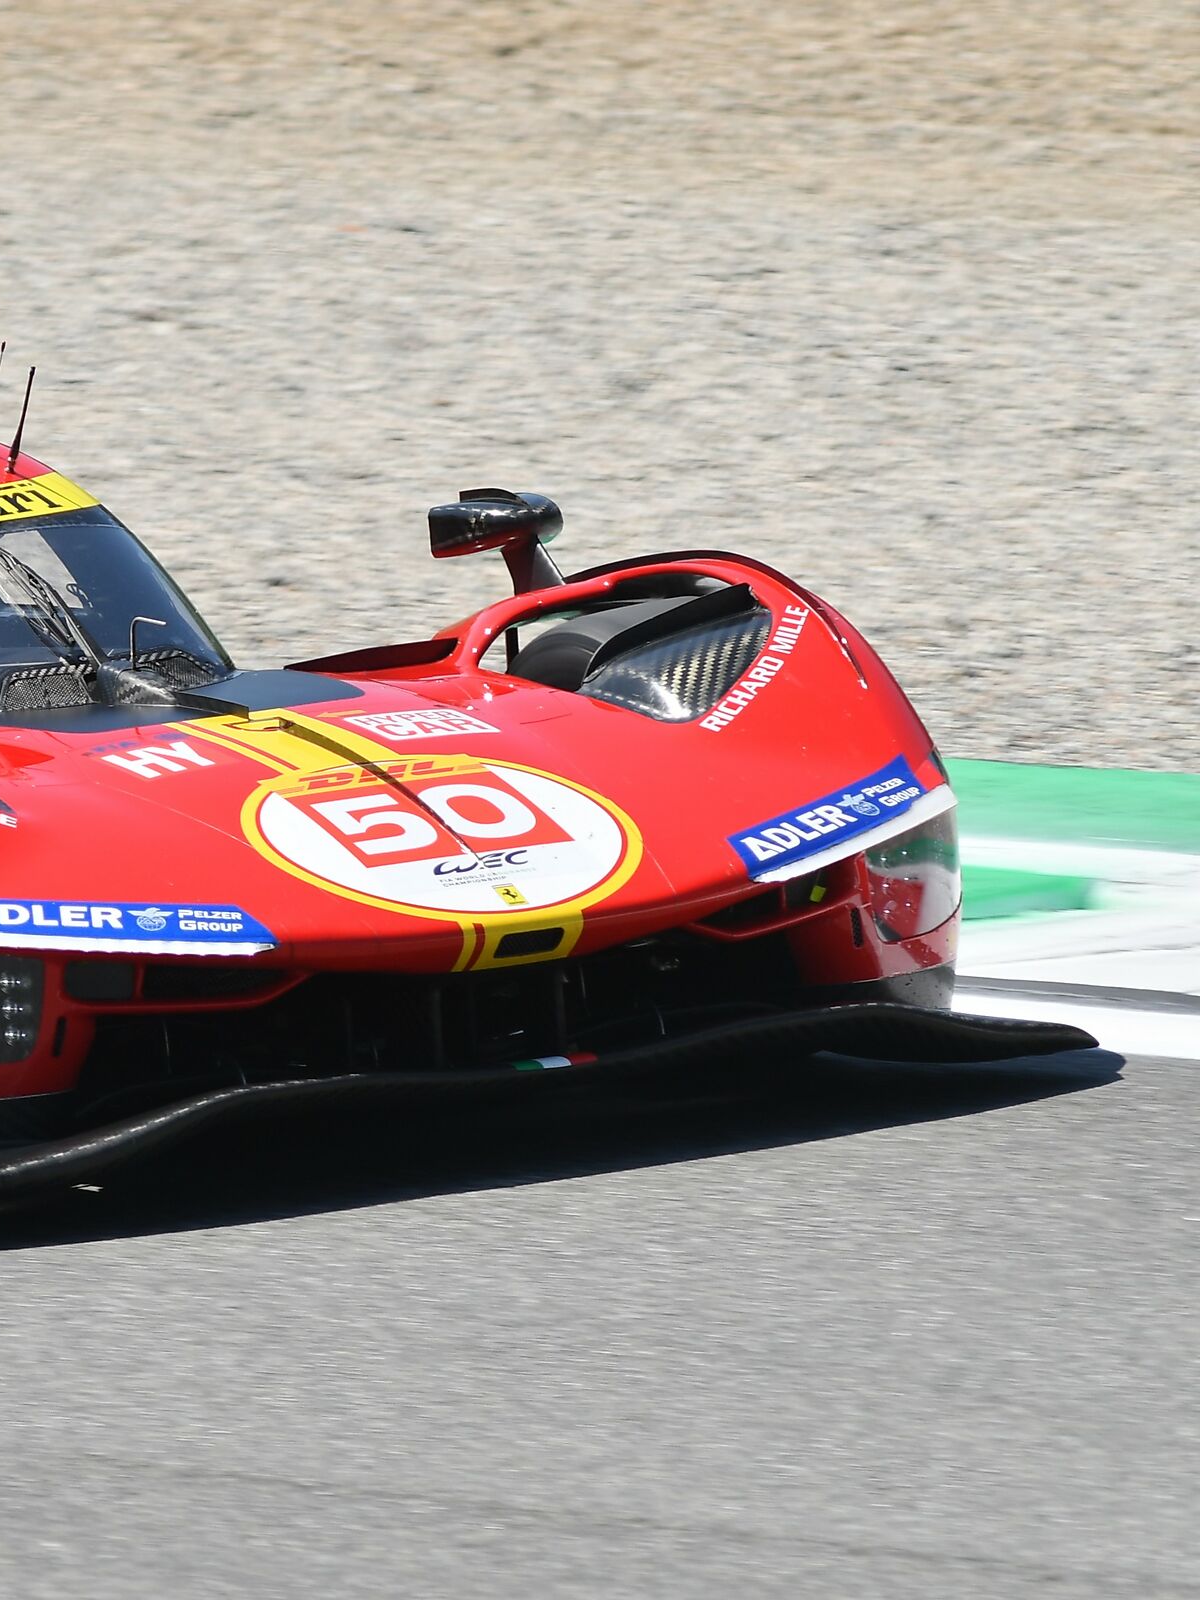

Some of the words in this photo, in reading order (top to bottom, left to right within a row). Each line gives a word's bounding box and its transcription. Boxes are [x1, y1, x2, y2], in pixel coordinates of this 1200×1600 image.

[699, 655, 784, 732] RICHARD
[768, 605, 810, 655] MILLE
[355, 710, 461, 726] HYPER
[375, 718, 490, 737] CAR
[101, 741, 216, 779] HY
[298, 760, 454, 791] DHL
[861, 777, 906, 797] PELZER
[878, 786, 920, 807] GROUP
[309, 783, 537, 856] 50
[740, 804, 858, 862] ADLER
[433, 849, 528, 876] WEC
[178, 909, 242, 921] PELZER
[179, 920, 243, 933] GROUP
